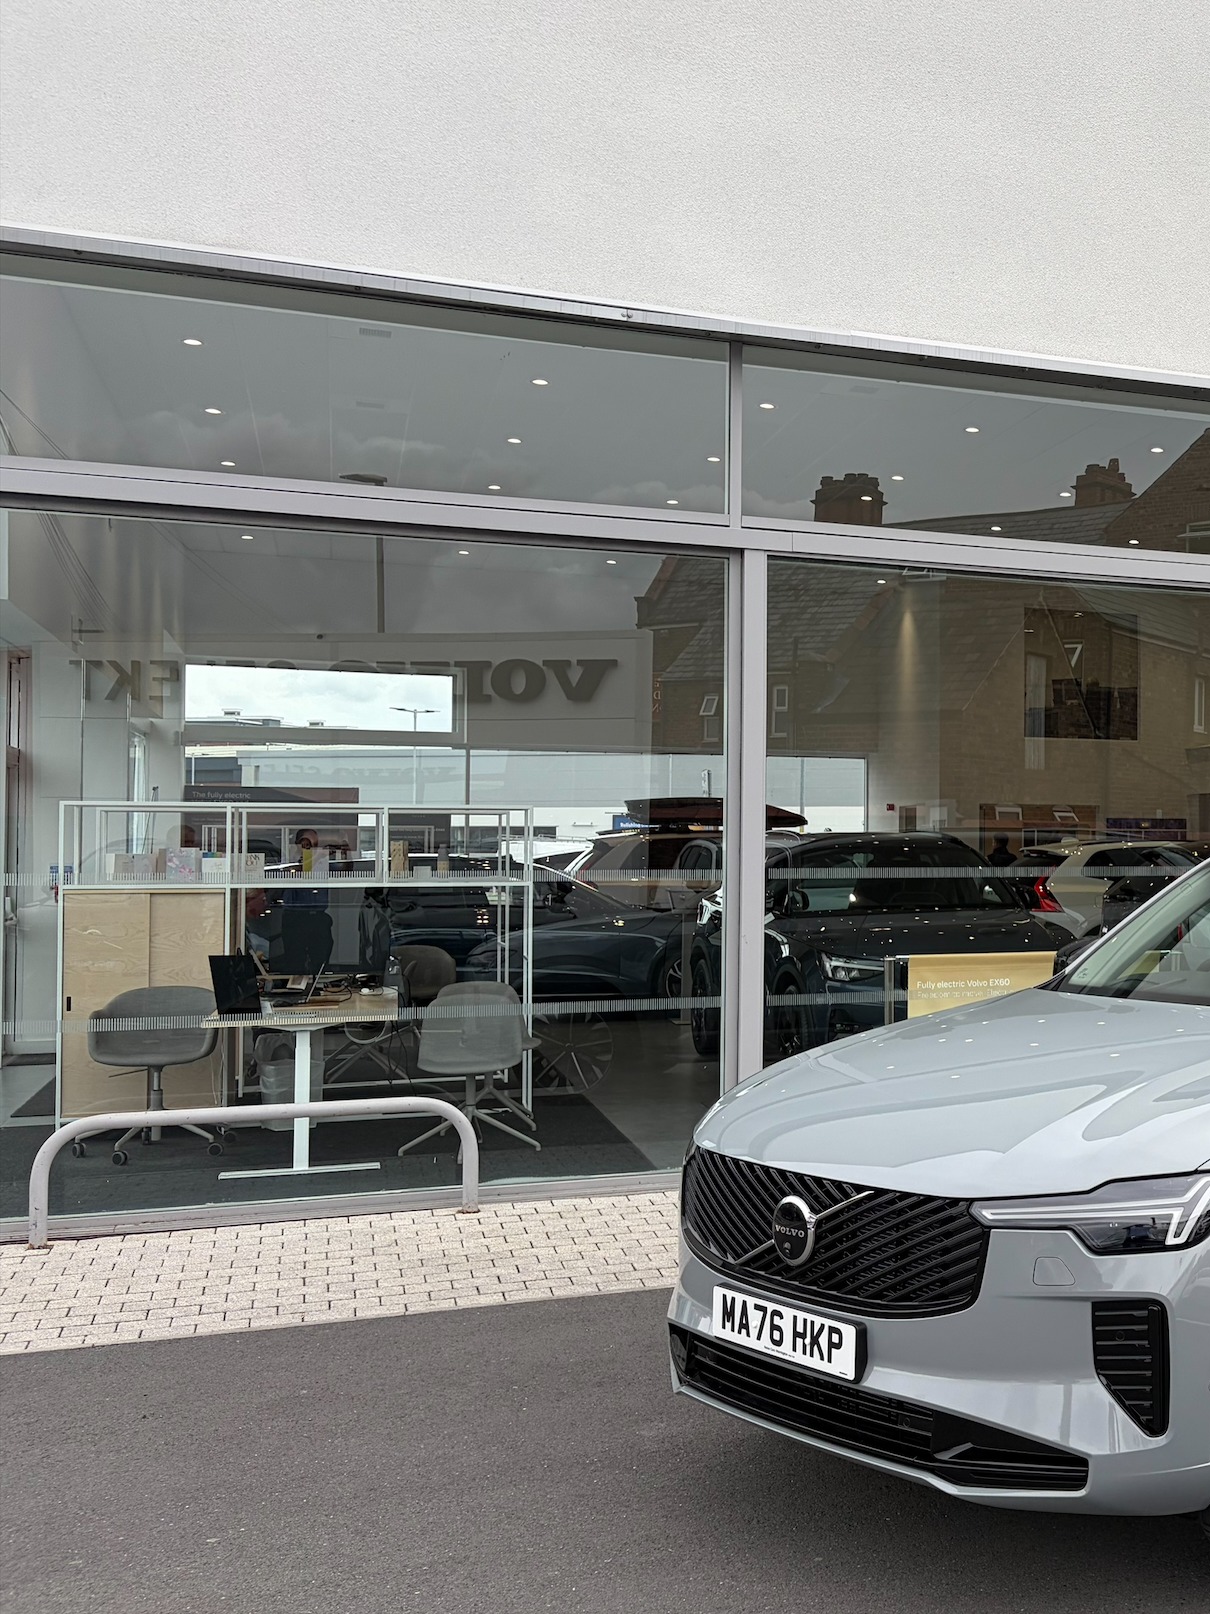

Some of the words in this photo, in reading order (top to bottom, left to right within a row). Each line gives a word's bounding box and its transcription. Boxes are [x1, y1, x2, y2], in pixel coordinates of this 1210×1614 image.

[207, 791, 223, 799] fully
[917, 981, 935, 989] Fully
[937, 980, 965, 988] electric
[966, 979, 988, 987] Volvo
[989, 978, 1010, 986] EX60
[775, 1224, 805, 1238] VOLVO
[721, 1293, 784, 1347] MA76
[792, 1314, 843, 1364] HKP
